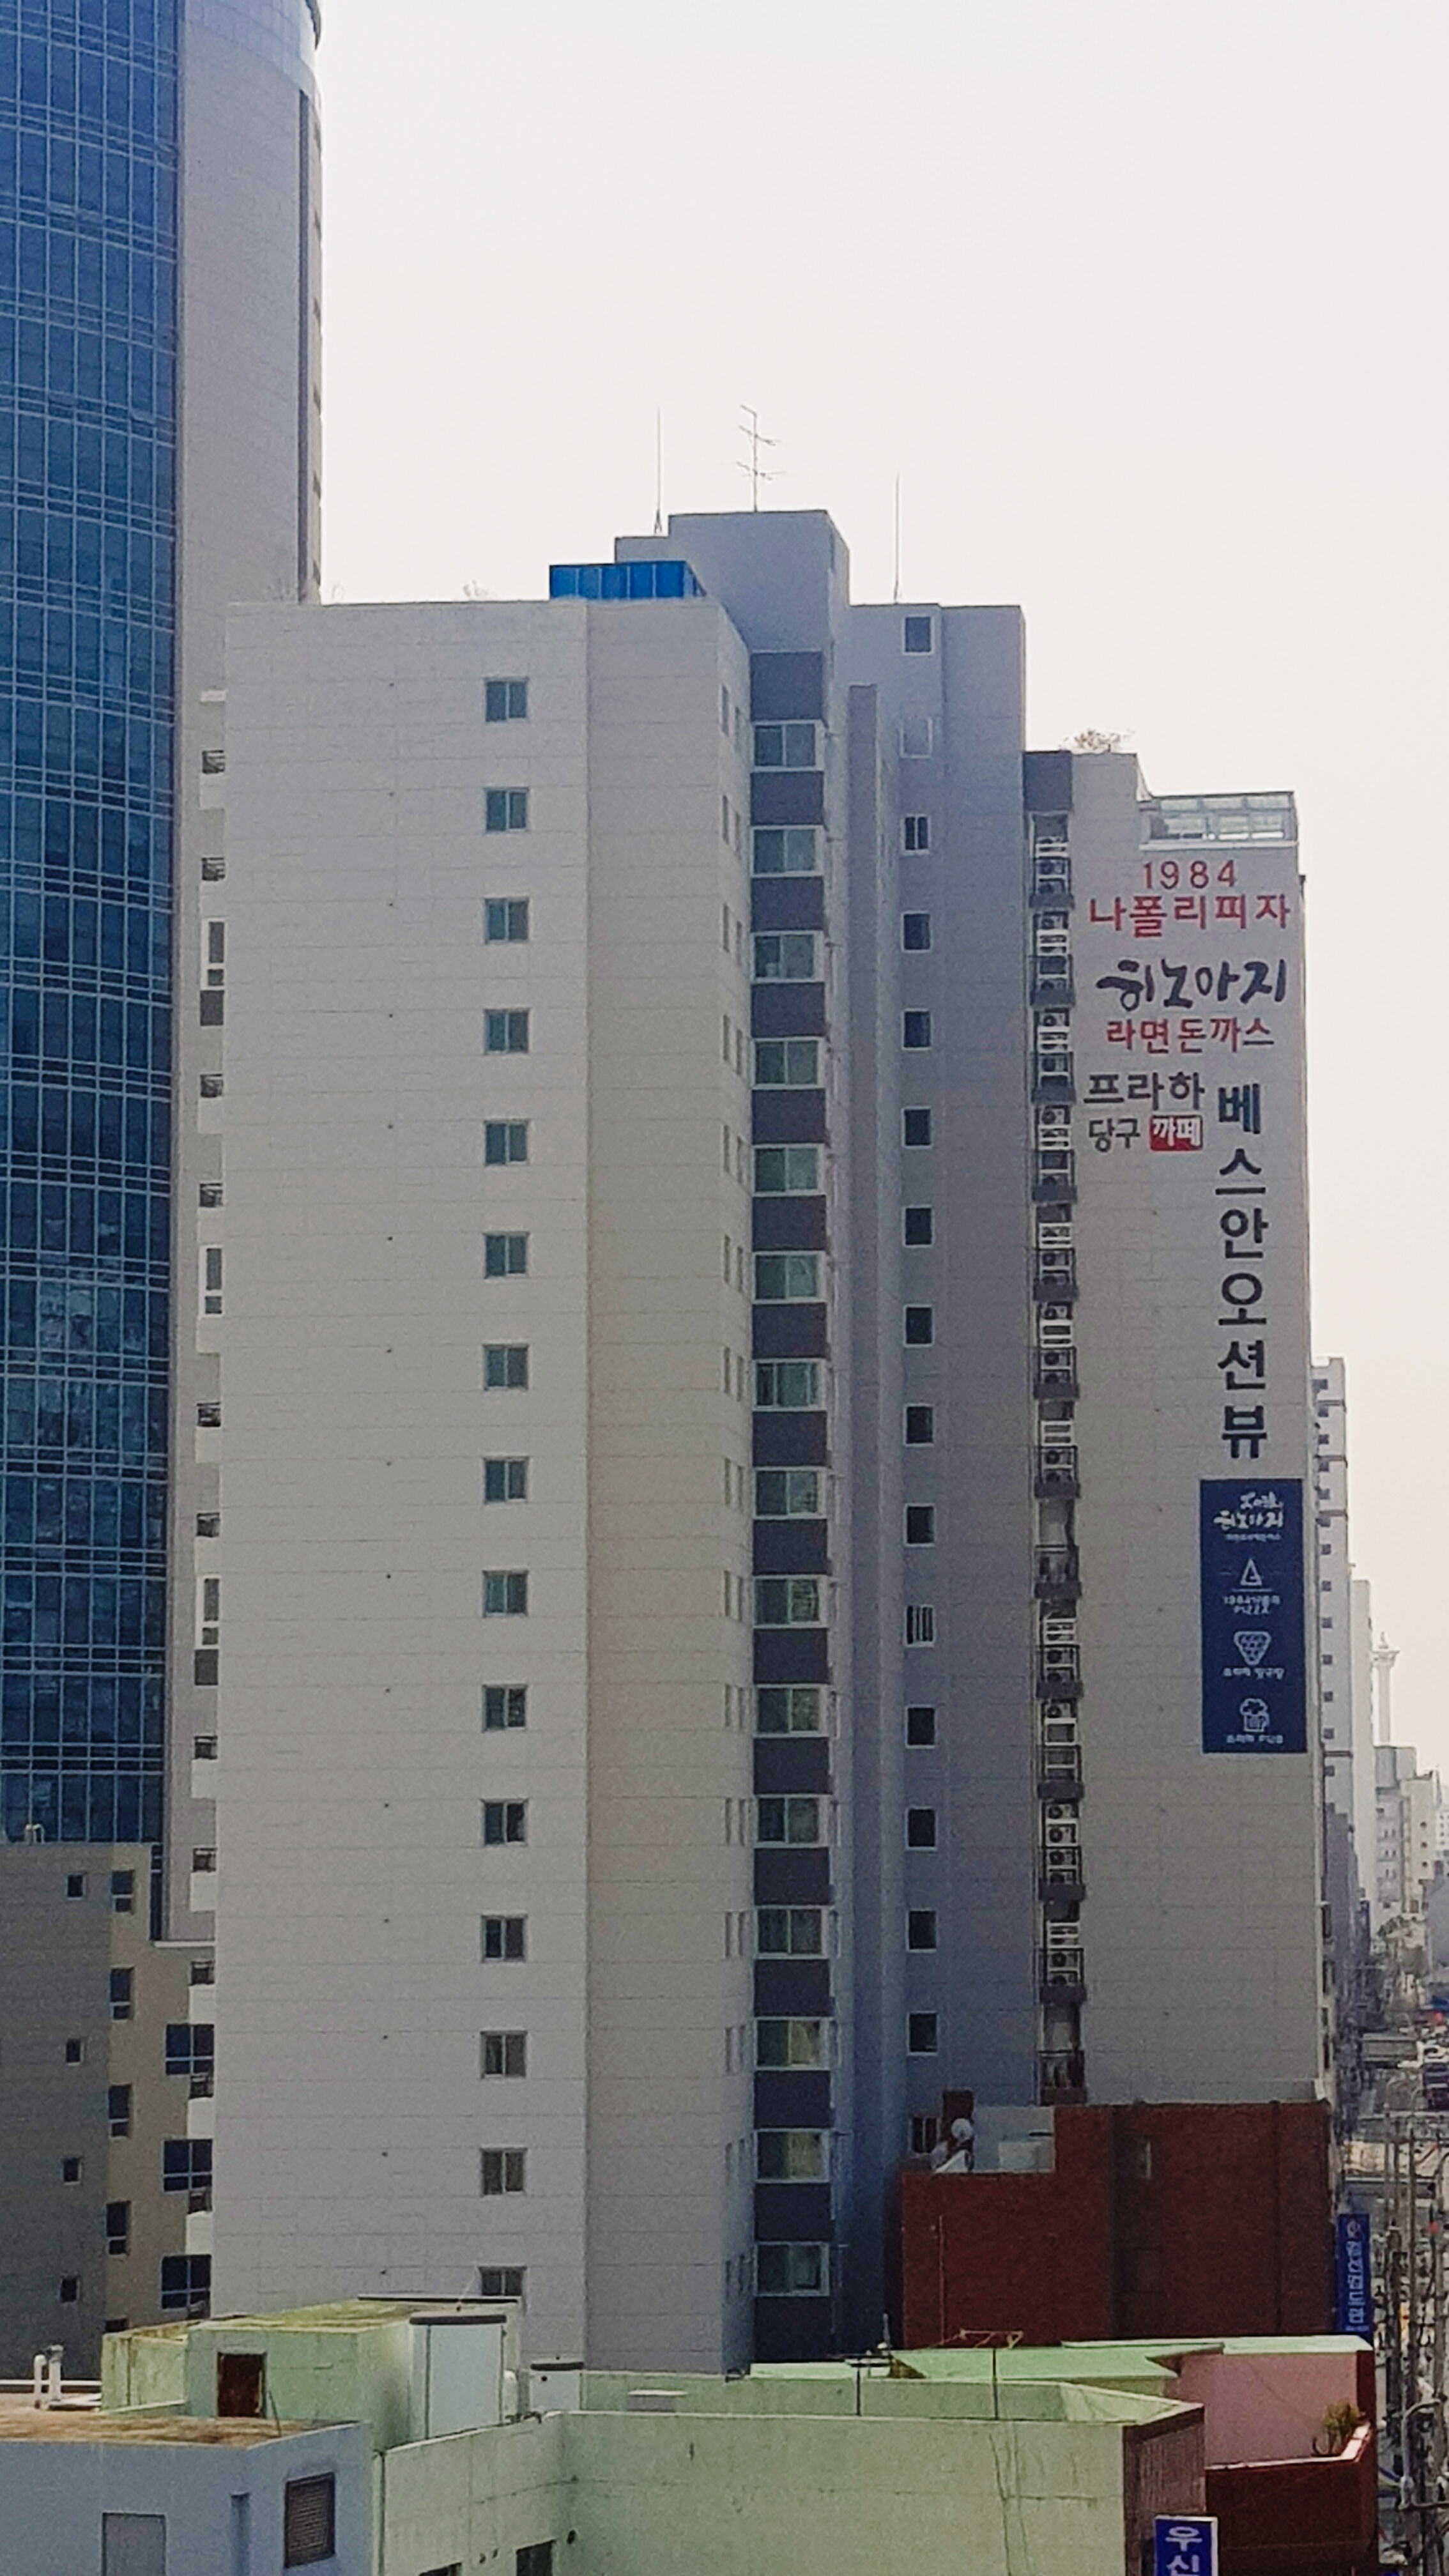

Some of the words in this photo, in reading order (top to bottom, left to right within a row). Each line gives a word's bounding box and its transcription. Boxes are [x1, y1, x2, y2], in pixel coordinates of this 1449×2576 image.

[1142, 860, 1236, 889] 1984
[1090, 894, 1291, 937] 나폴리피자
[1097, 960, 1285, 1010] 히노아지
[1107, 1019, 1274, 1053] 라면돈까스
[1084, 1073, 1205, 1110] 프라하
[1089, 1119, 1140, 1152] 당구
[1153, 1117, 1200, 1146] 까페
